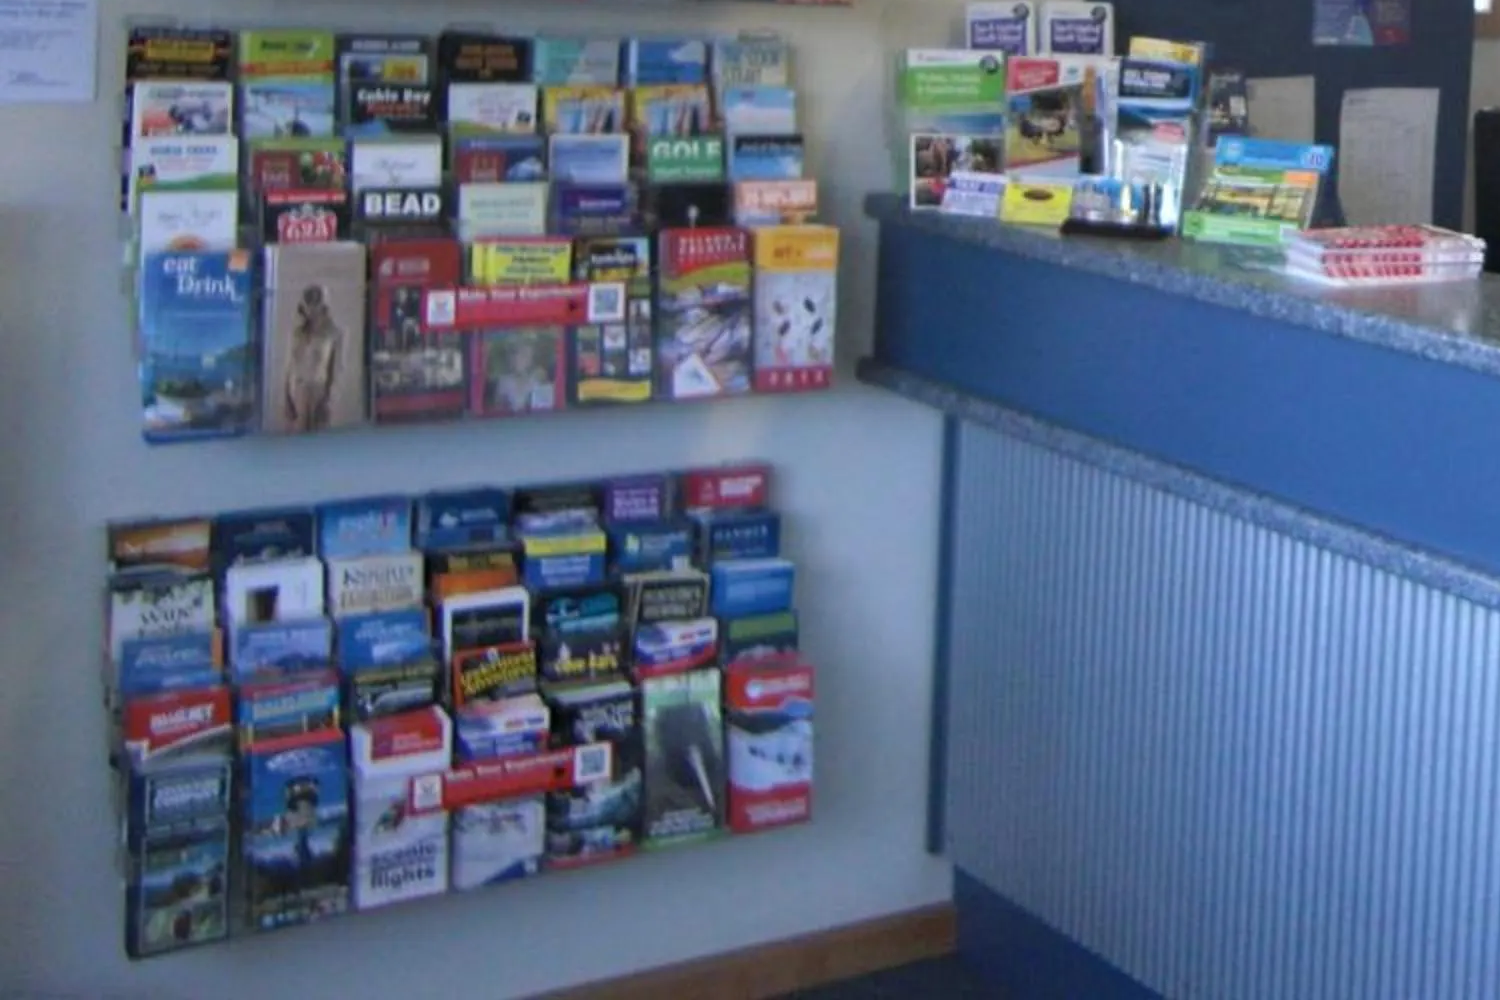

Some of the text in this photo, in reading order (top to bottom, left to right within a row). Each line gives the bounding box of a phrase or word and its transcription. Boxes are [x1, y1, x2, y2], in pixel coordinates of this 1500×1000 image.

[652, 140, 722, 161] GOLF
[365, 192, 442, 216] BEAD
[163, 257, 198, 275] eat
[177, 275, 243, 301] Drink
[369, 862, 436, 891] flights
